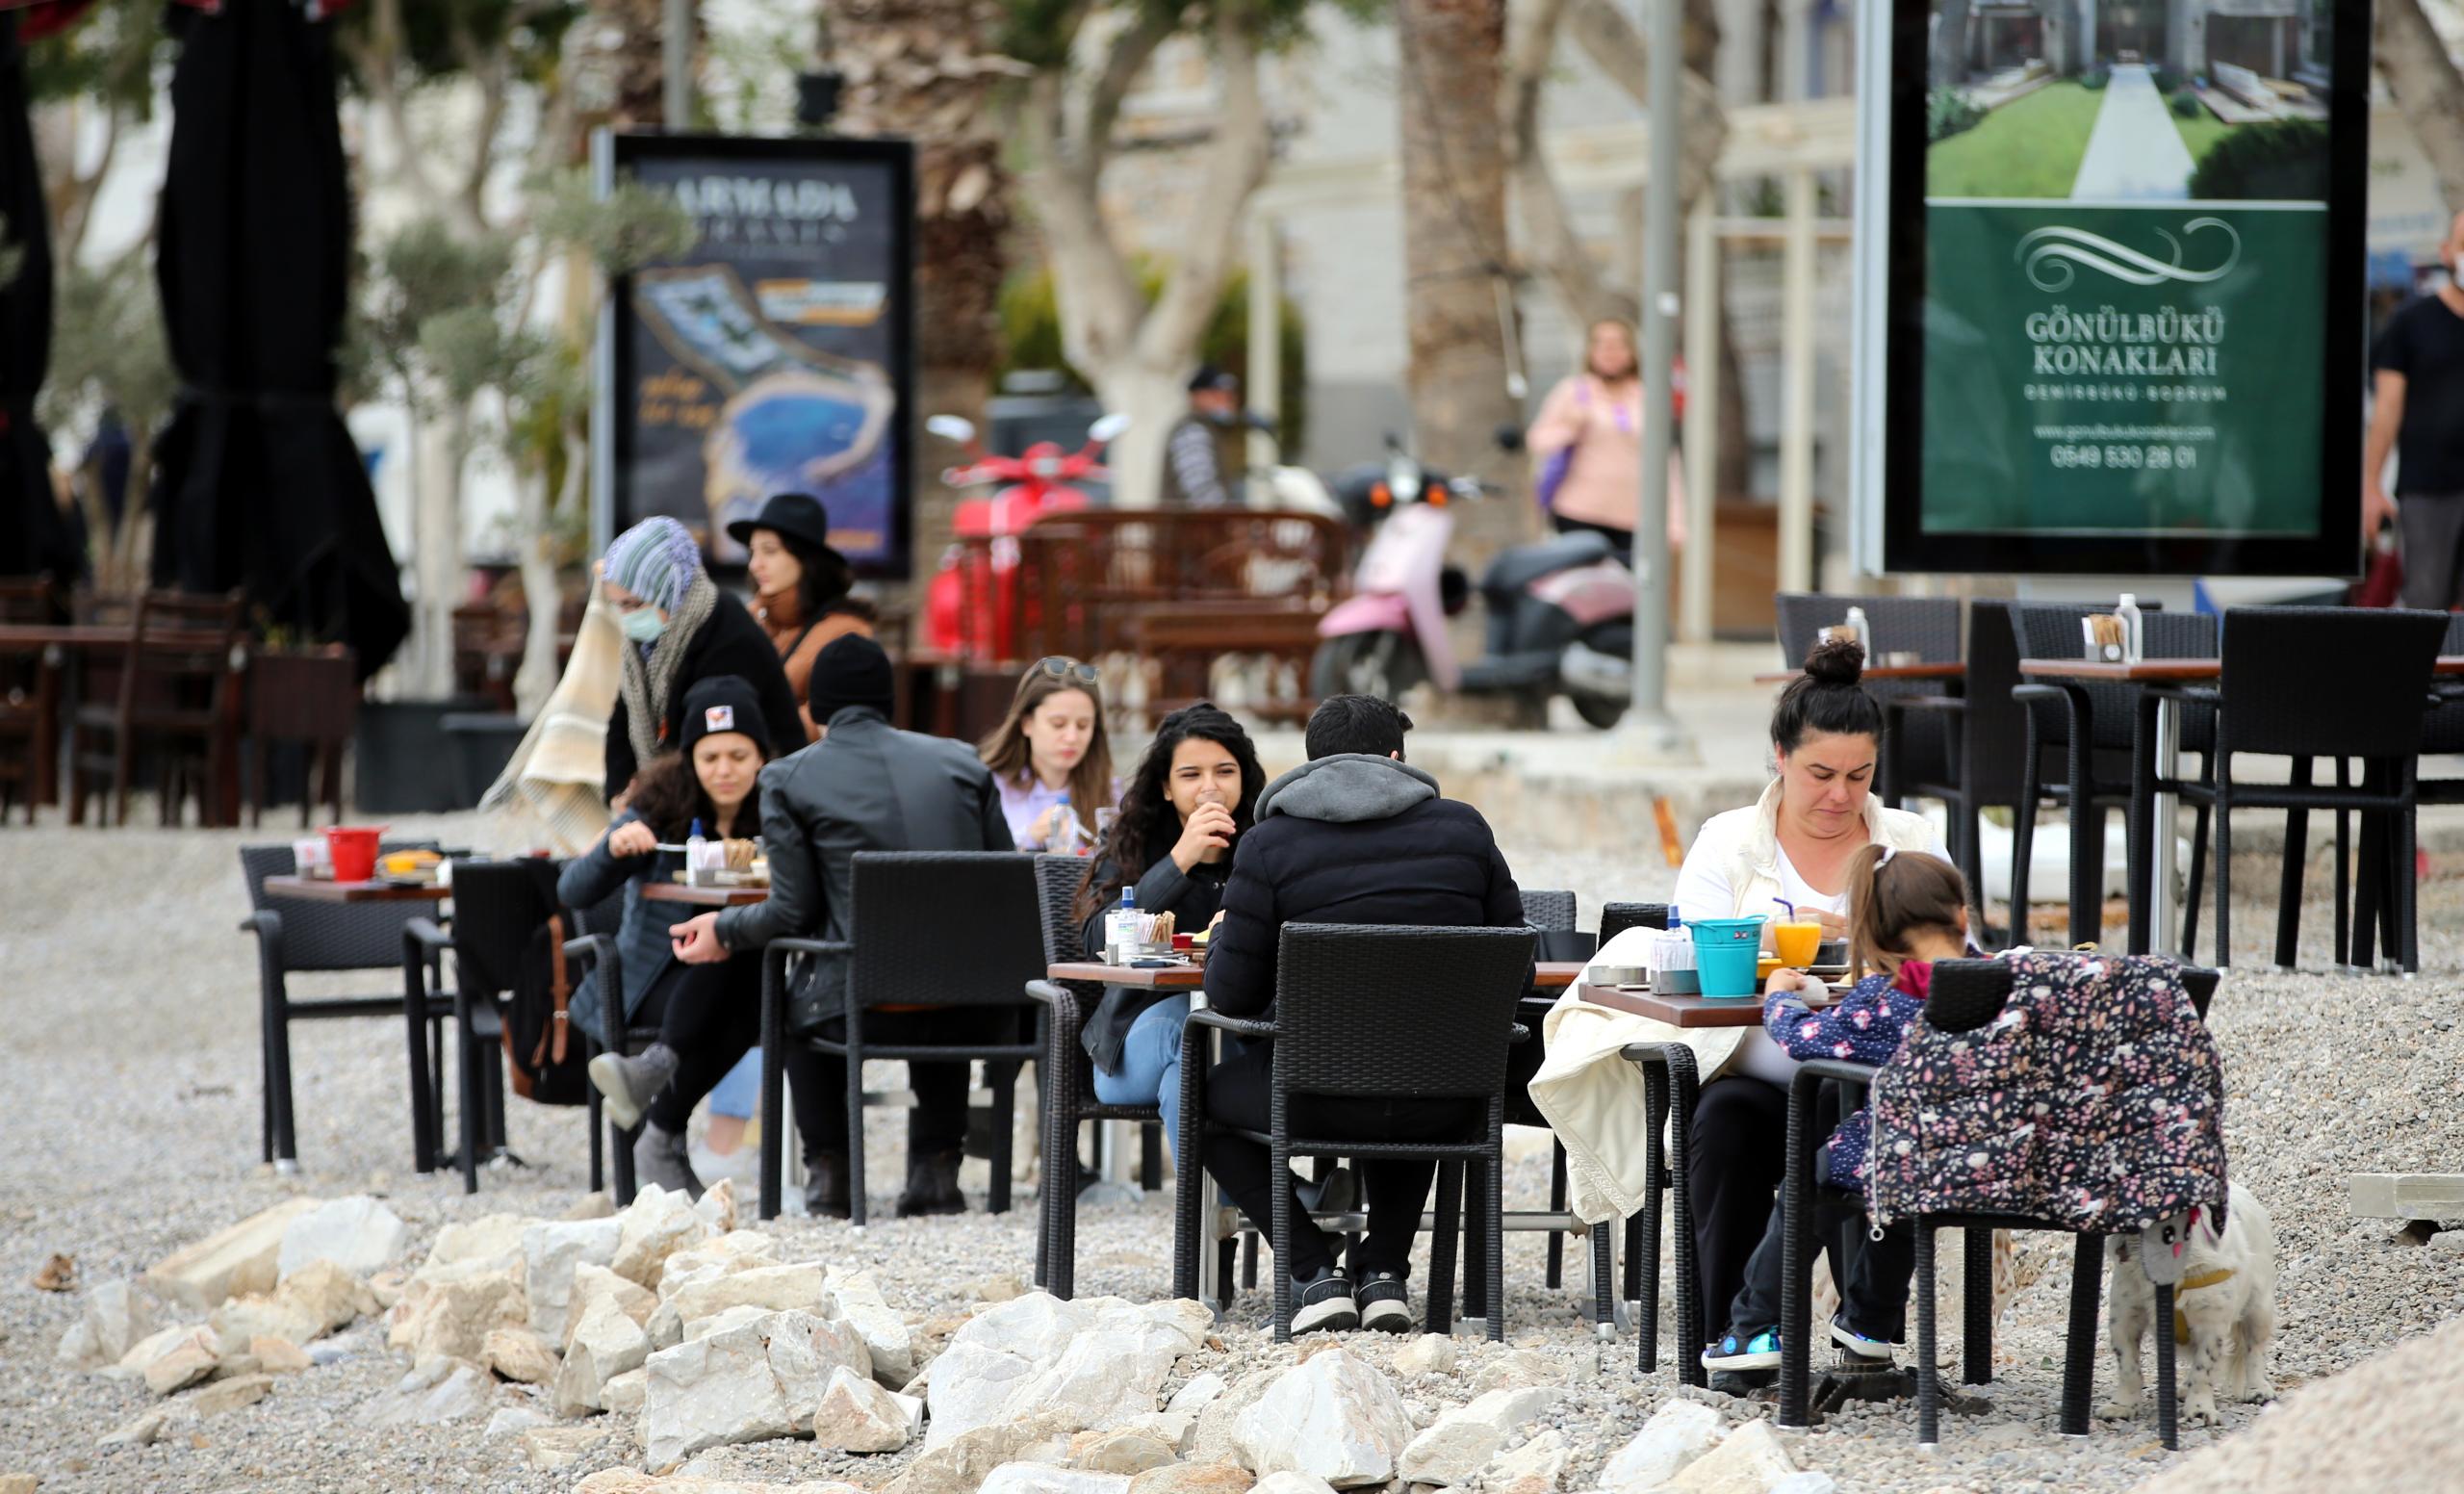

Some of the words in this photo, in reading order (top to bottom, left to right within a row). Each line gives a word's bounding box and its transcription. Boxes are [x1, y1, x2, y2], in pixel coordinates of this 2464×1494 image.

[2025, 304, 2225, 344] GÖNÜLBÜKÜ
[2033, 345, 2218, 375] KONAKLARI
[2050, 445, 2102, 469] 0549
[2104, 445, 2143, 469] 530
[2174, 446, 2197, 470] 01
